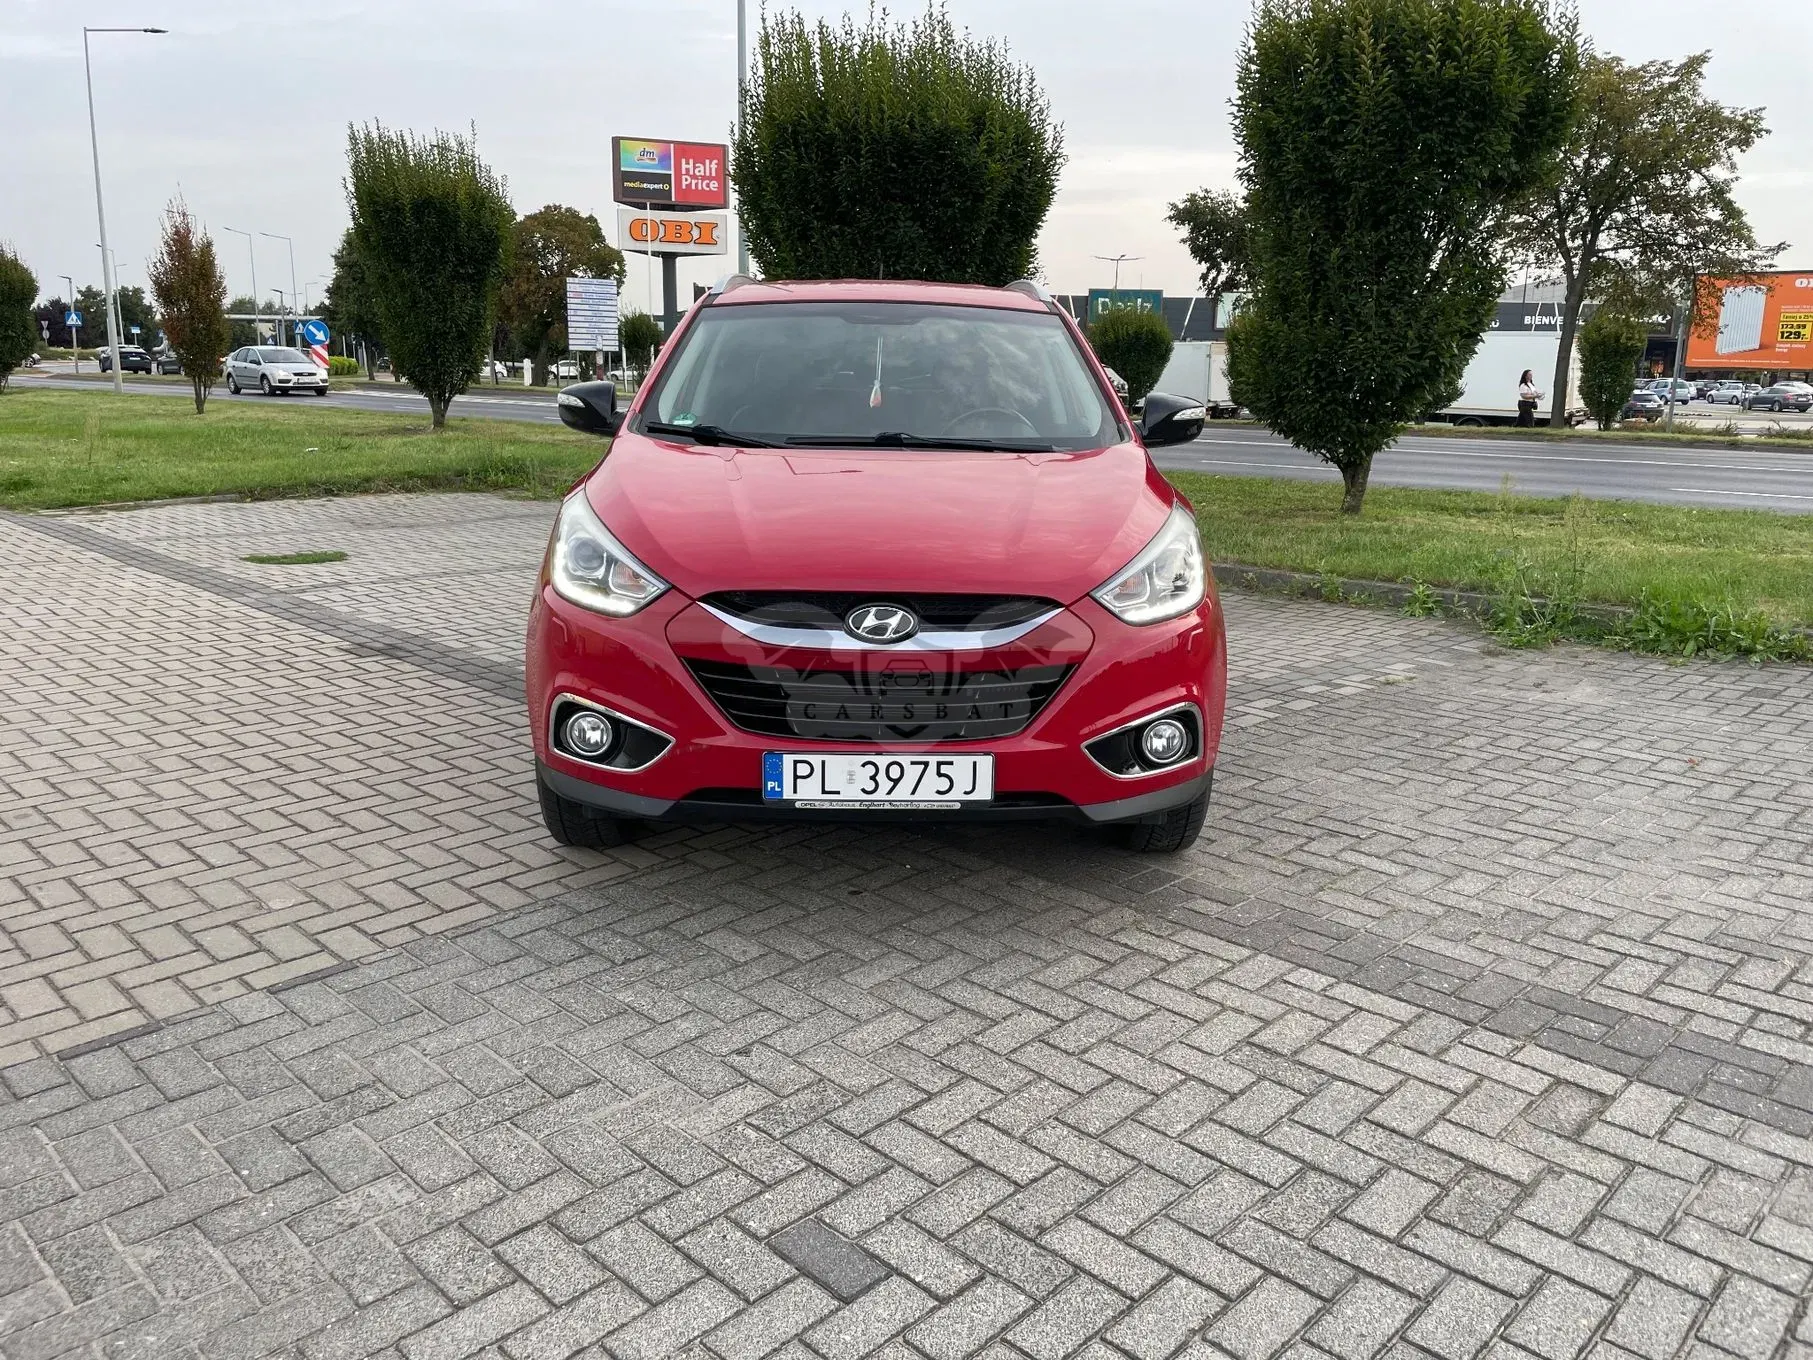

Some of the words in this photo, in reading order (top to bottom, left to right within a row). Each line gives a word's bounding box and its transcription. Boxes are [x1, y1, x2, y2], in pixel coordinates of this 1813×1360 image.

[639, 147, 656, 158] dm
[681, 158, 718, 176] Half
[682, 174, 718, 191] Price
[629, 218, 719, 245] OBI
[767, 781, 782, 791] PL
[792, 759, 841, 795] PL
[859, 760, 978, 796] 3975J
